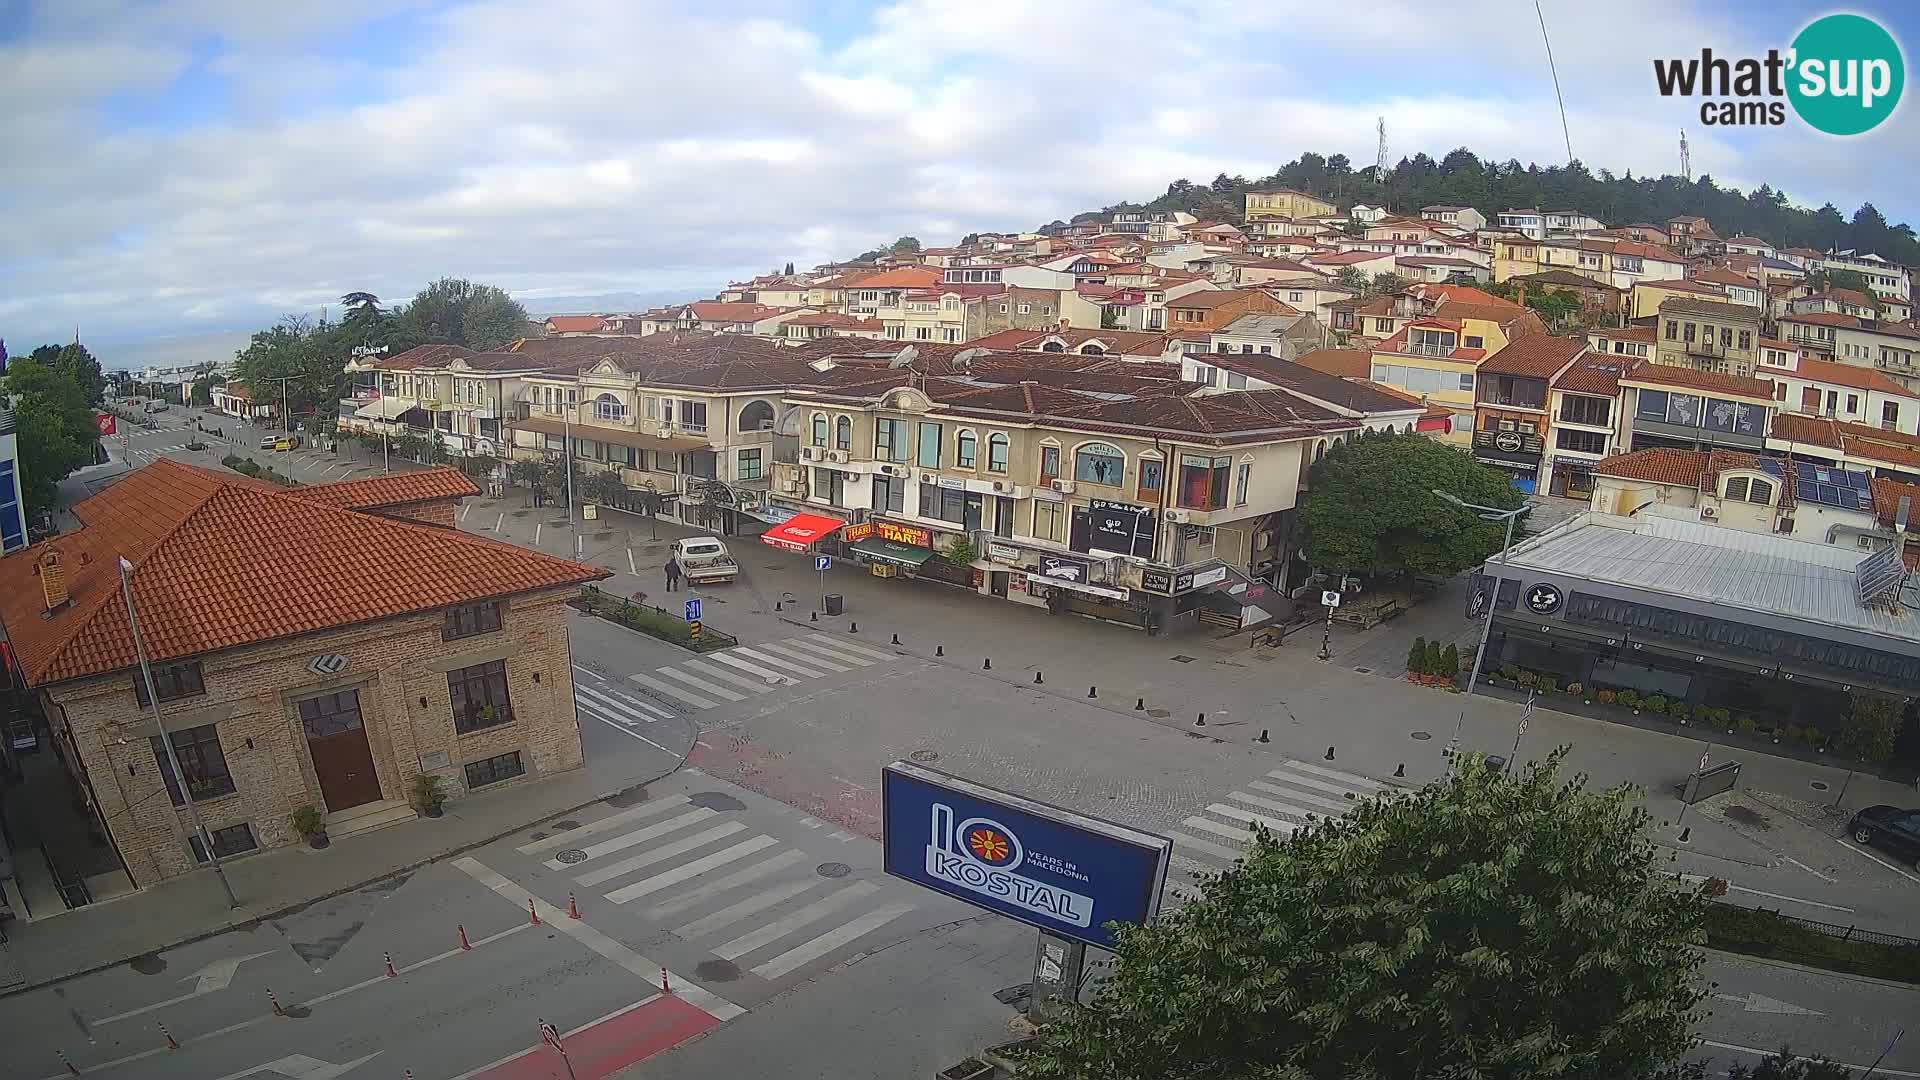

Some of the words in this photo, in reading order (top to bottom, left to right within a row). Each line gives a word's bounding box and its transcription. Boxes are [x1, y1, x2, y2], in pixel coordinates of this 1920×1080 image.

[1027, 849, 1063, 867] YEARS
[1065, 861, 1077, 870] IN
[1027, 857, 1089, 883] MACEDONIA
[935, 851, 1082, 922] KOSTAL
